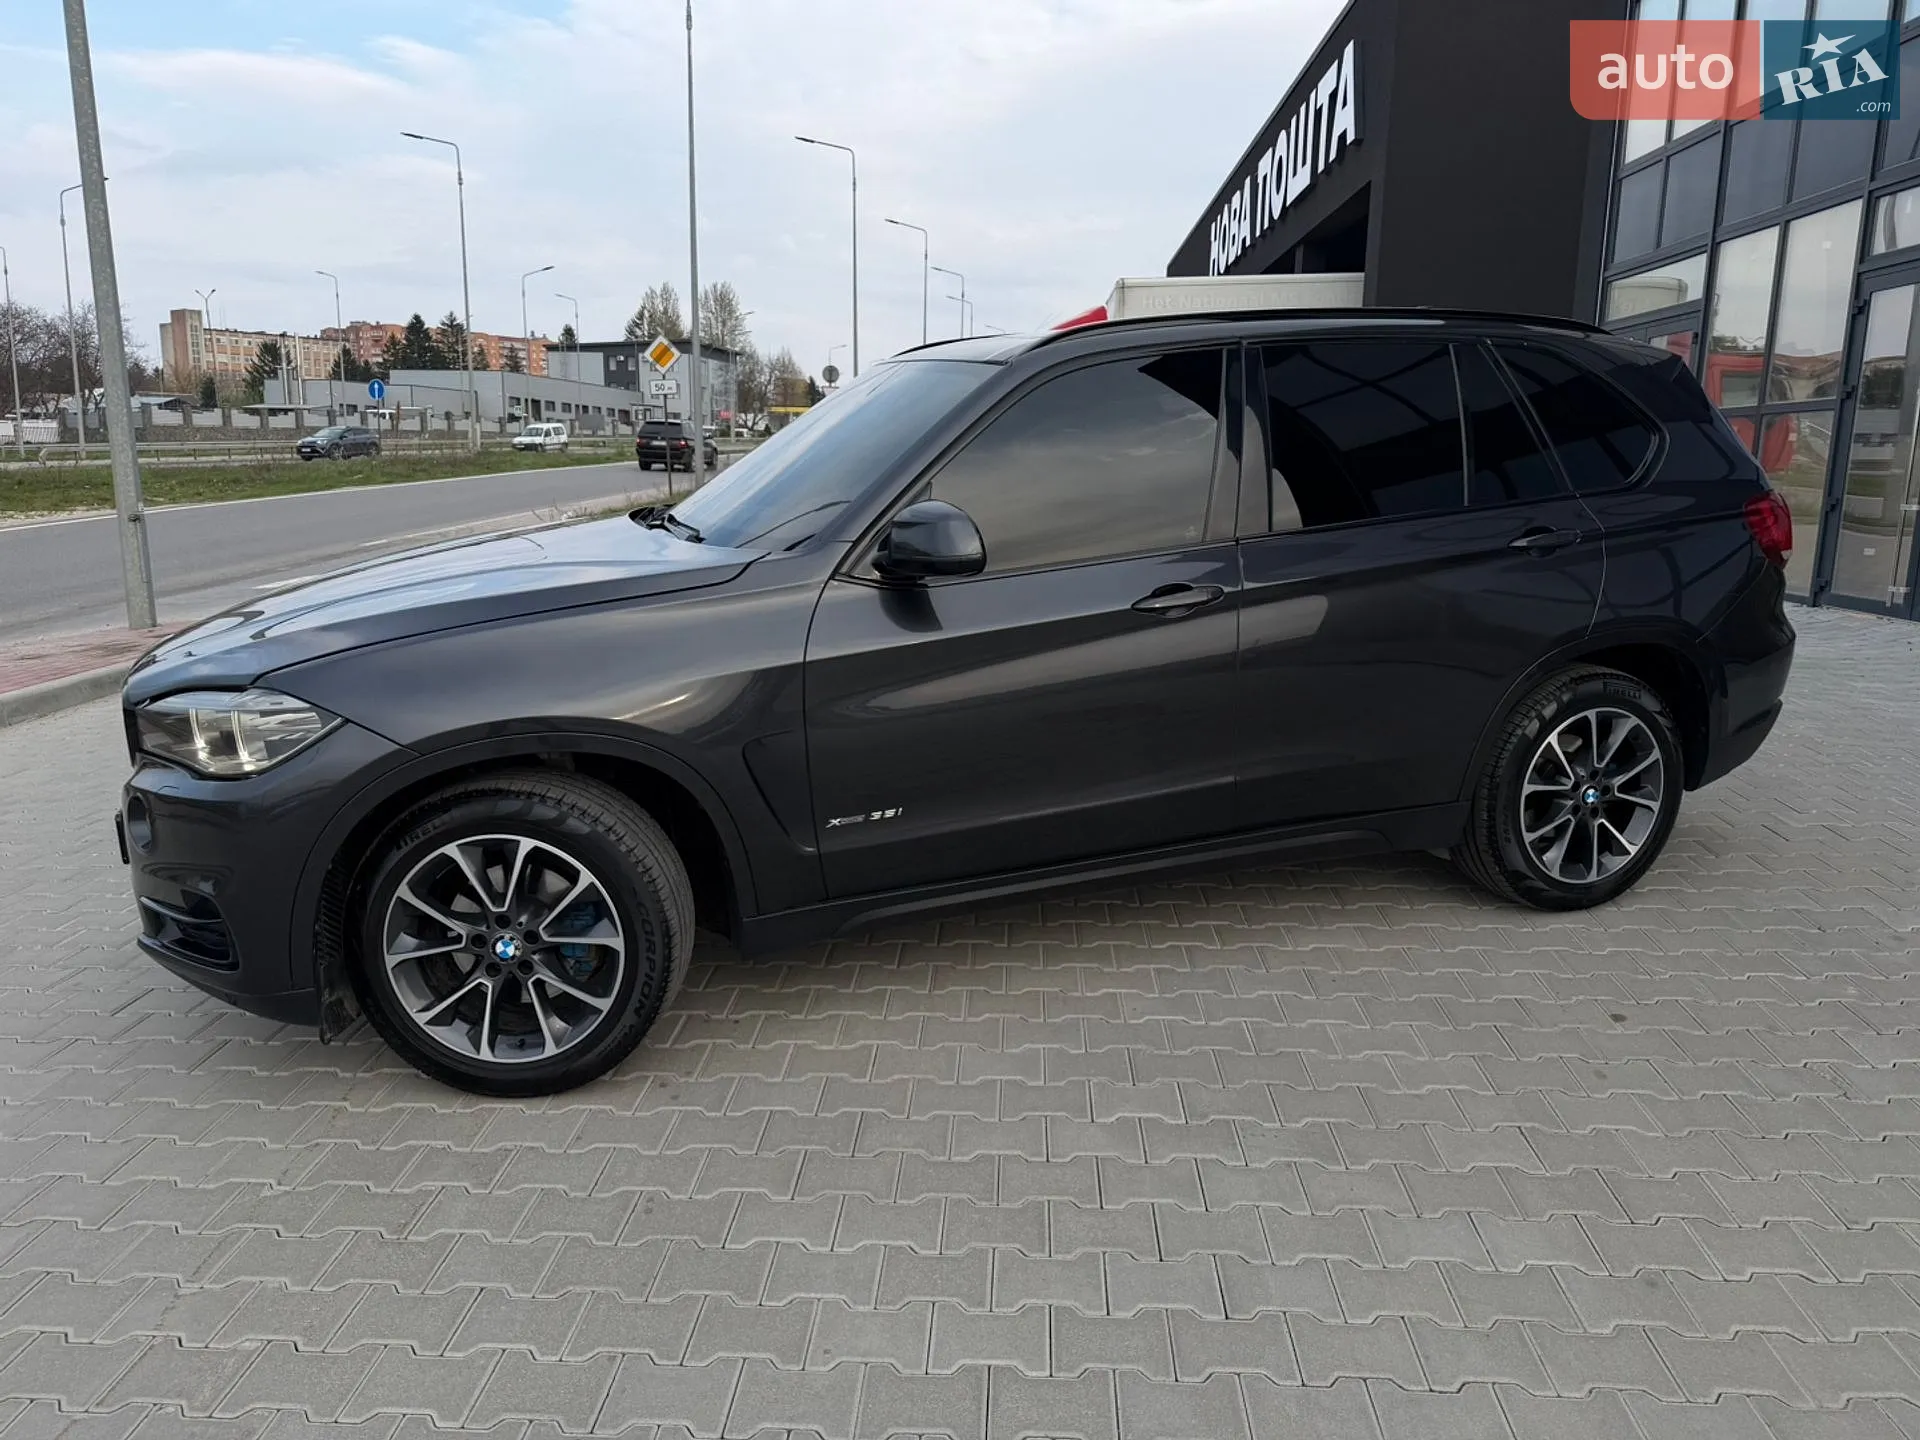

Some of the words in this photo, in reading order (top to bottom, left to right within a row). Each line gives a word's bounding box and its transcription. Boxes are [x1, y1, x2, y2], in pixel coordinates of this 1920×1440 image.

[1209, 175, 1251, 276] НОВА
[1255, 39, 1358, 238] ПОШТА
[654, 382, 665, 391] 50
